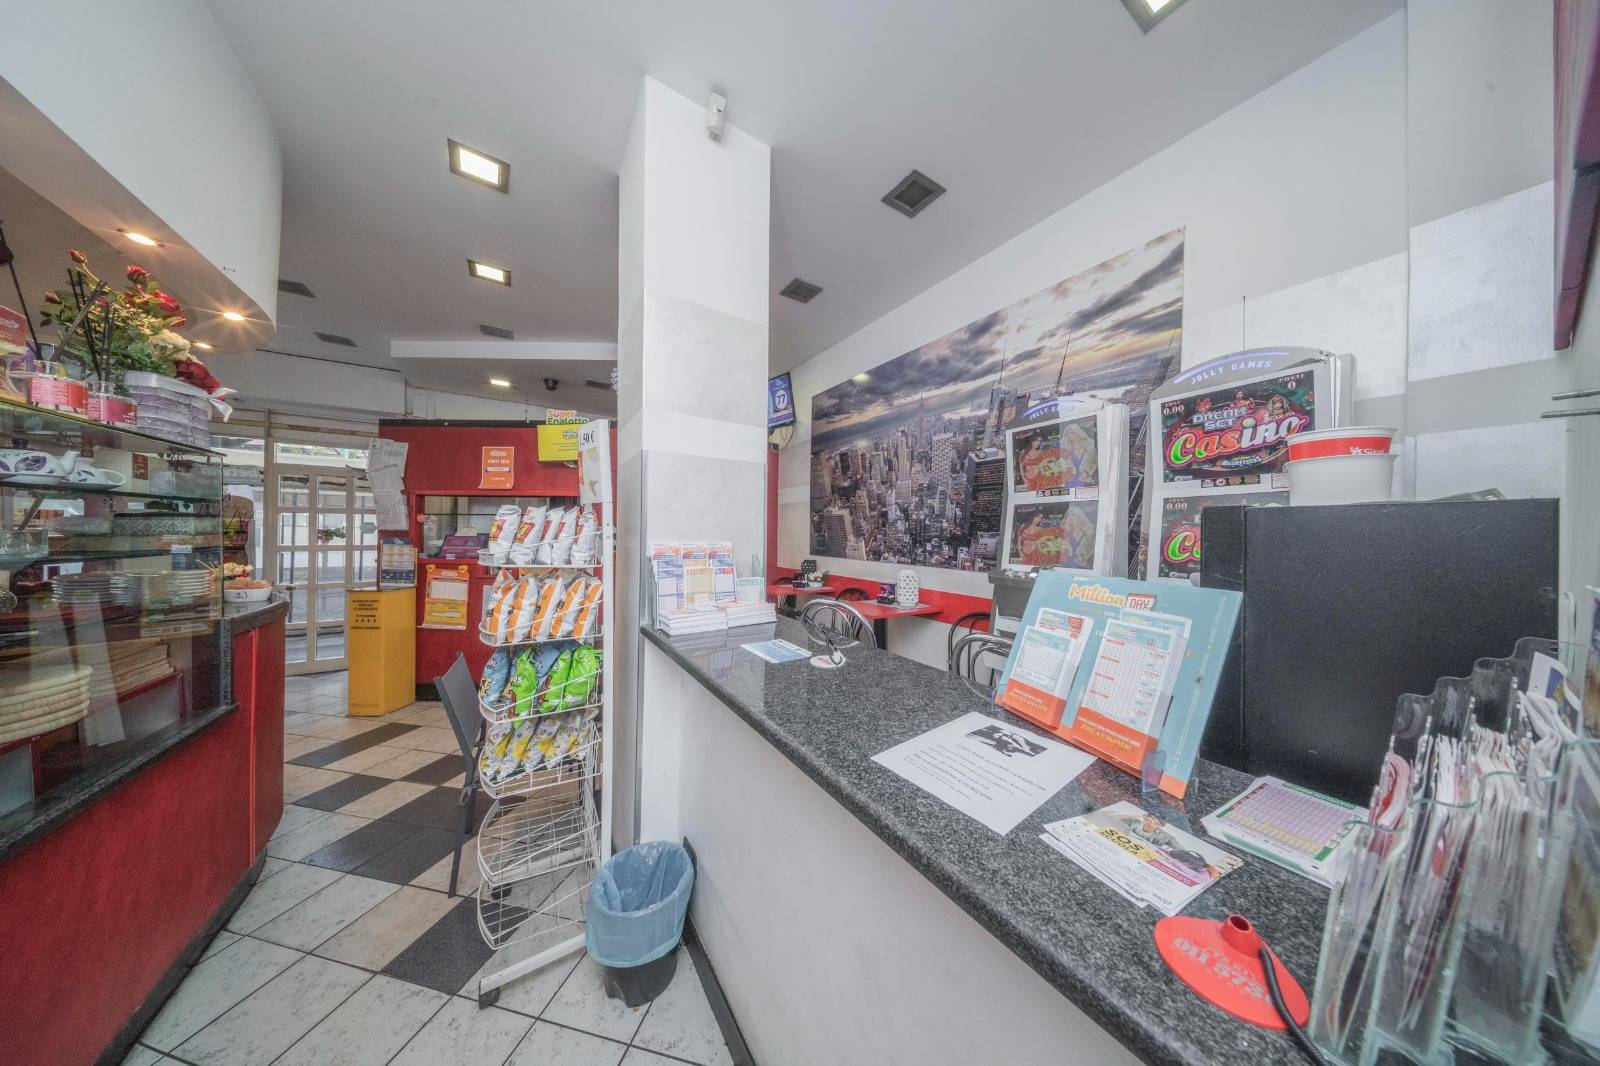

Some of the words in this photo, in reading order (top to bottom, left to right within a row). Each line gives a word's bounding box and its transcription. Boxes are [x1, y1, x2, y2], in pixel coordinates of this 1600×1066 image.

[1231, 360, 1273, 371] GAMES
[1192, 407, 1248, 425] DREAM
[1170, 414, 1306, 465] Casino
[1068, 584, 1125, 606] Million
[1129, 598, 1151, 610] DAY
[1103, 829, 1144, 851] SOS
